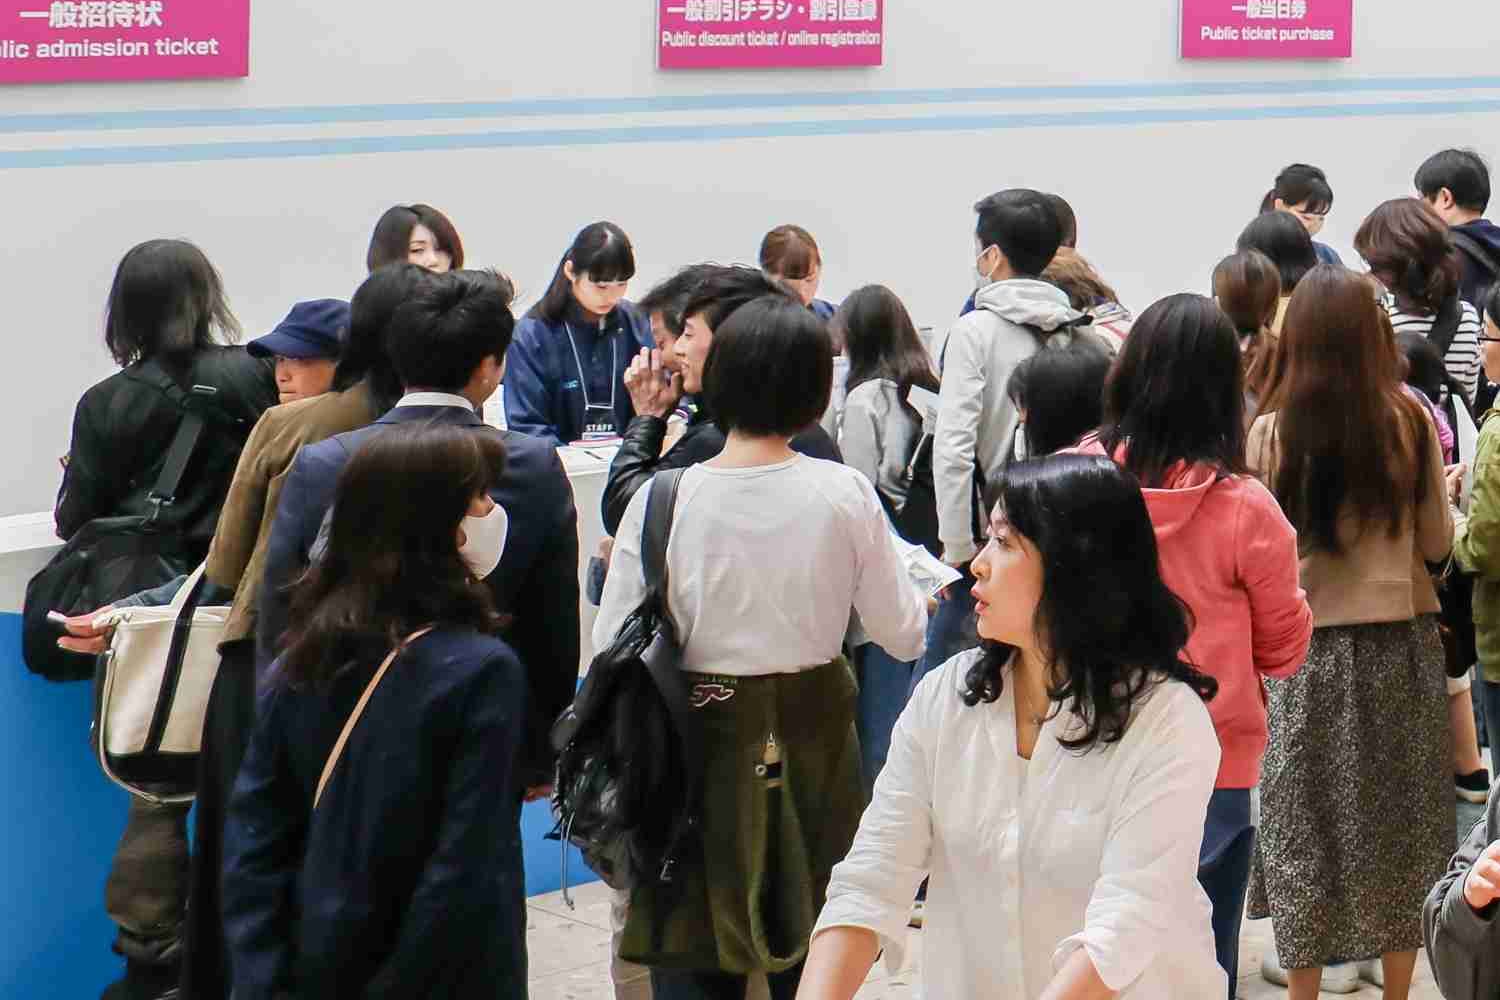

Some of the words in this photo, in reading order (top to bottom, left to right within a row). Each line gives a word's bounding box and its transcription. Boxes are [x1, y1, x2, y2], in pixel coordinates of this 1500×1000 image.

[19, 0, 164, 29] 一般招待状
[661, 30, 697, 47] Public
[699, 31, 746, 46] discount
[748, 30, 780, 46] ticket
[788, 30, 820, 46] online
[821, 29, 881, 48] registration
[1200, 26, 1239, 41] Public
[1241, 26, 1278, 41] ticket
[1279, 27, 1335, 43] purchase
[36, 37, 149, 58] admission
[154, 37, 220, 57] ticket
